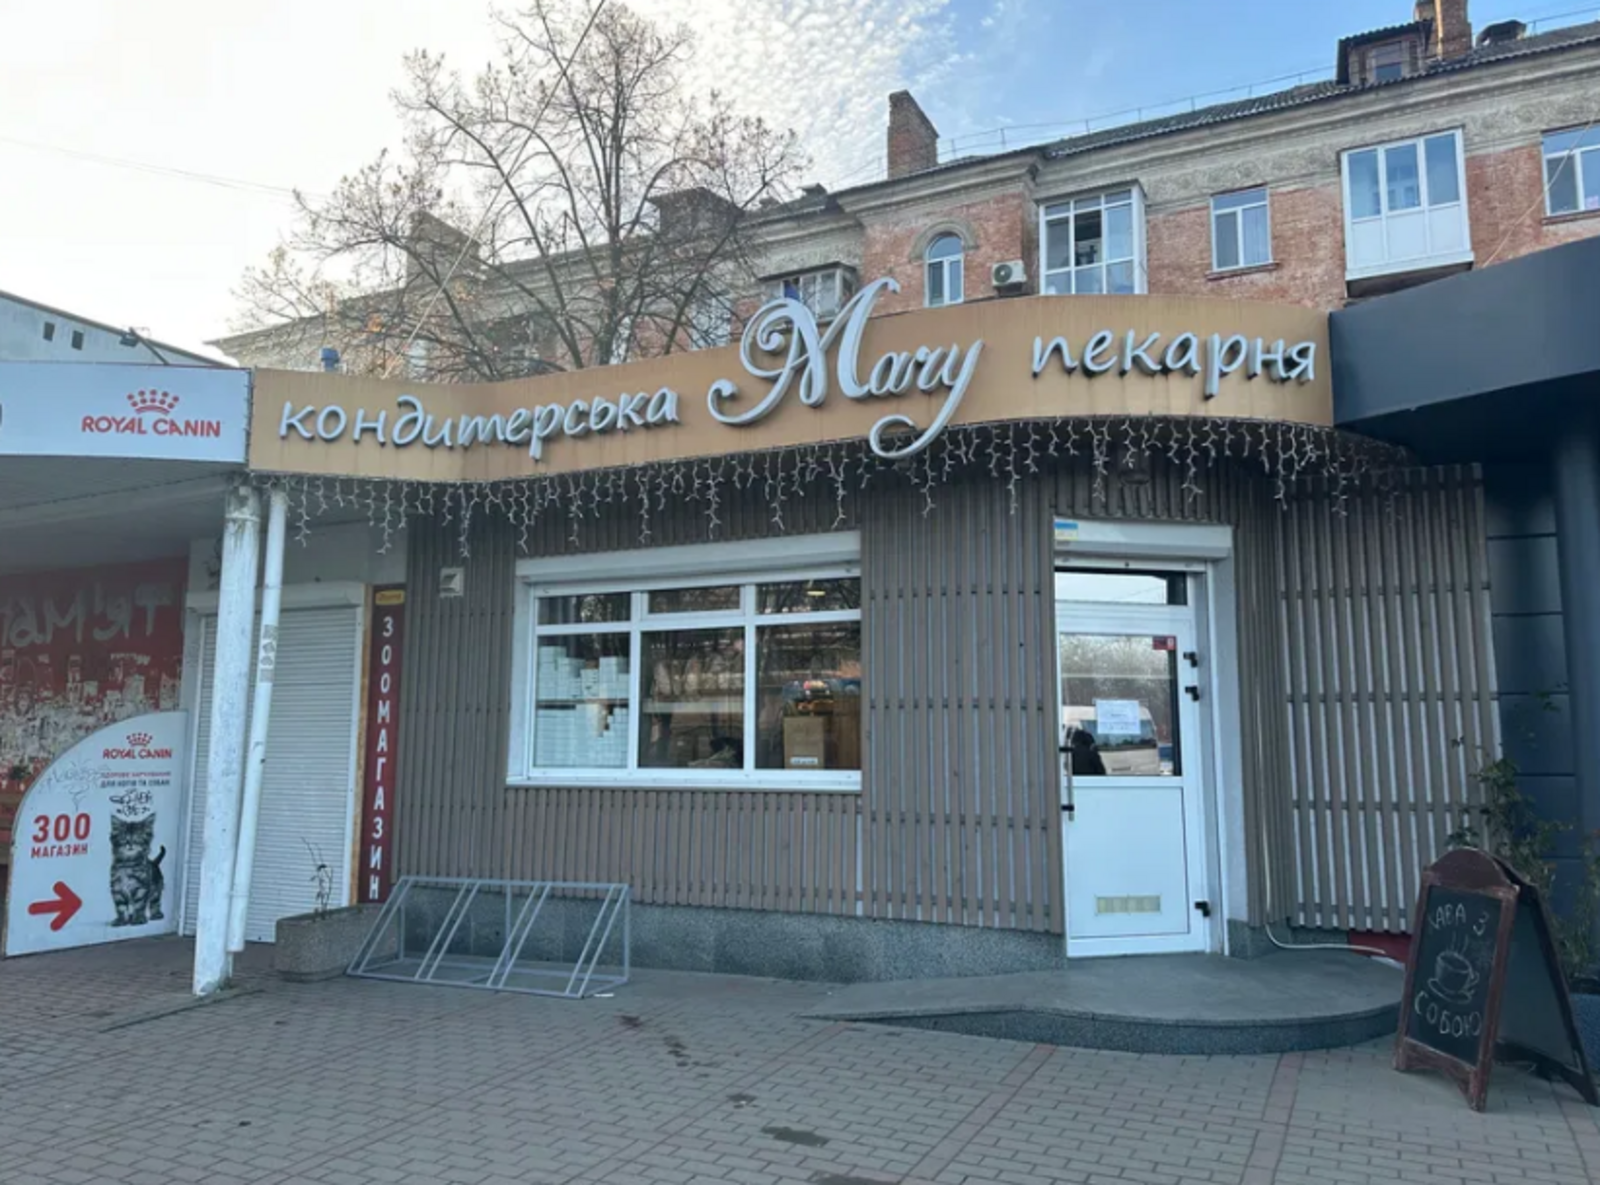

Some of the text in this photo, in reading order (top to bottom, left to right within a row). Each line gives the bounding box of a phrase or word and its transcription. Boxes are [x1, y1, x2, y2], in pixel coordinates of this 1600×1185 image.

[279, 276, 1317, 460] кондитерська Mary пекарня
[82, 415, 221, 438] ROYAL CANIN
[102, 748, 172, 760] ROYAL CANIN
[31, 843, 88, 858] МАГАЗИН
